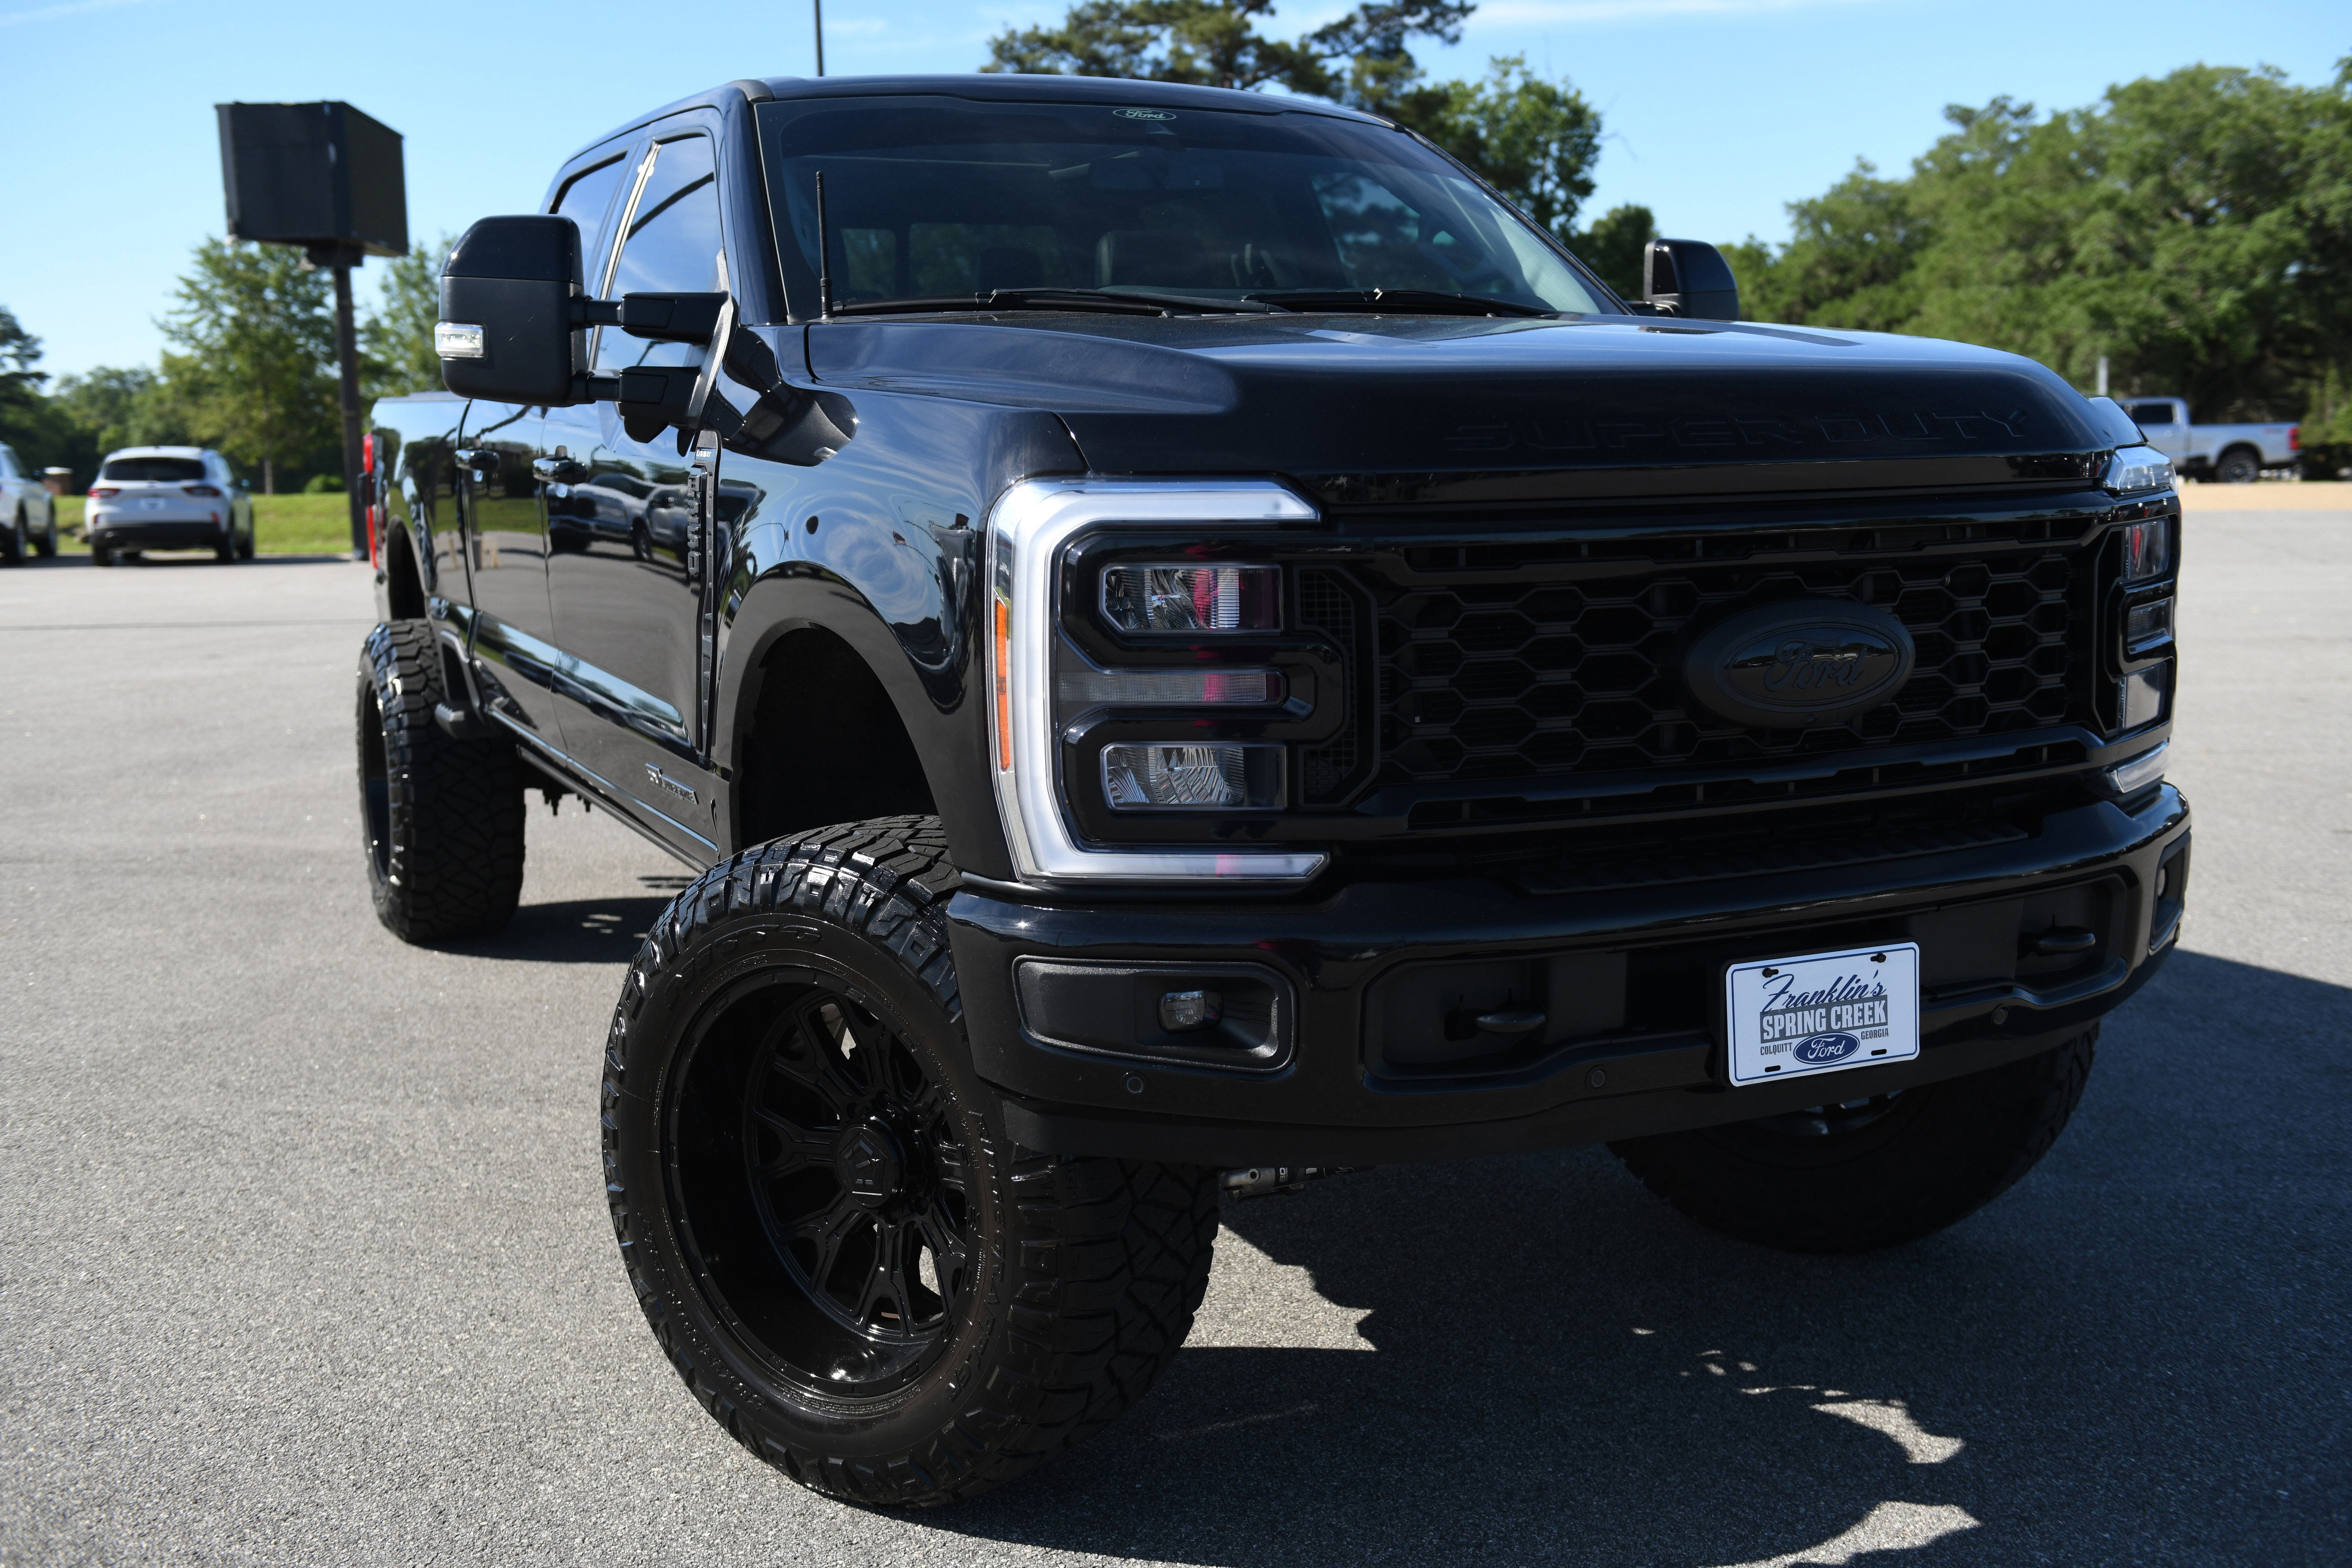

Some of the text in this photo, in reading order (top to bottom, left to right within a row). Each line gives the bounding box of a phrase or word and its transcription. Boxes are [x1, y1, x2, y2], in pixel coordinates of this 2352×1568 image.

[1126, 109, 1166, 119] Ford
[1443, 409, 2029, 452] SUPER DUTY
[1764, 637, 1868, 692] Ford
[664, 923, 822, 1009] NITTO
[1762, 969, 1887, 1014] Franklin's
[1763, 1000, 1886, 1040] SPRING CREEK
[1861, 1027, 1889, 1040] GEORGIA
[1760, 1042, 1793, 1056] COLQUITT
[1807, 1037, 1846, 1059] Ford
